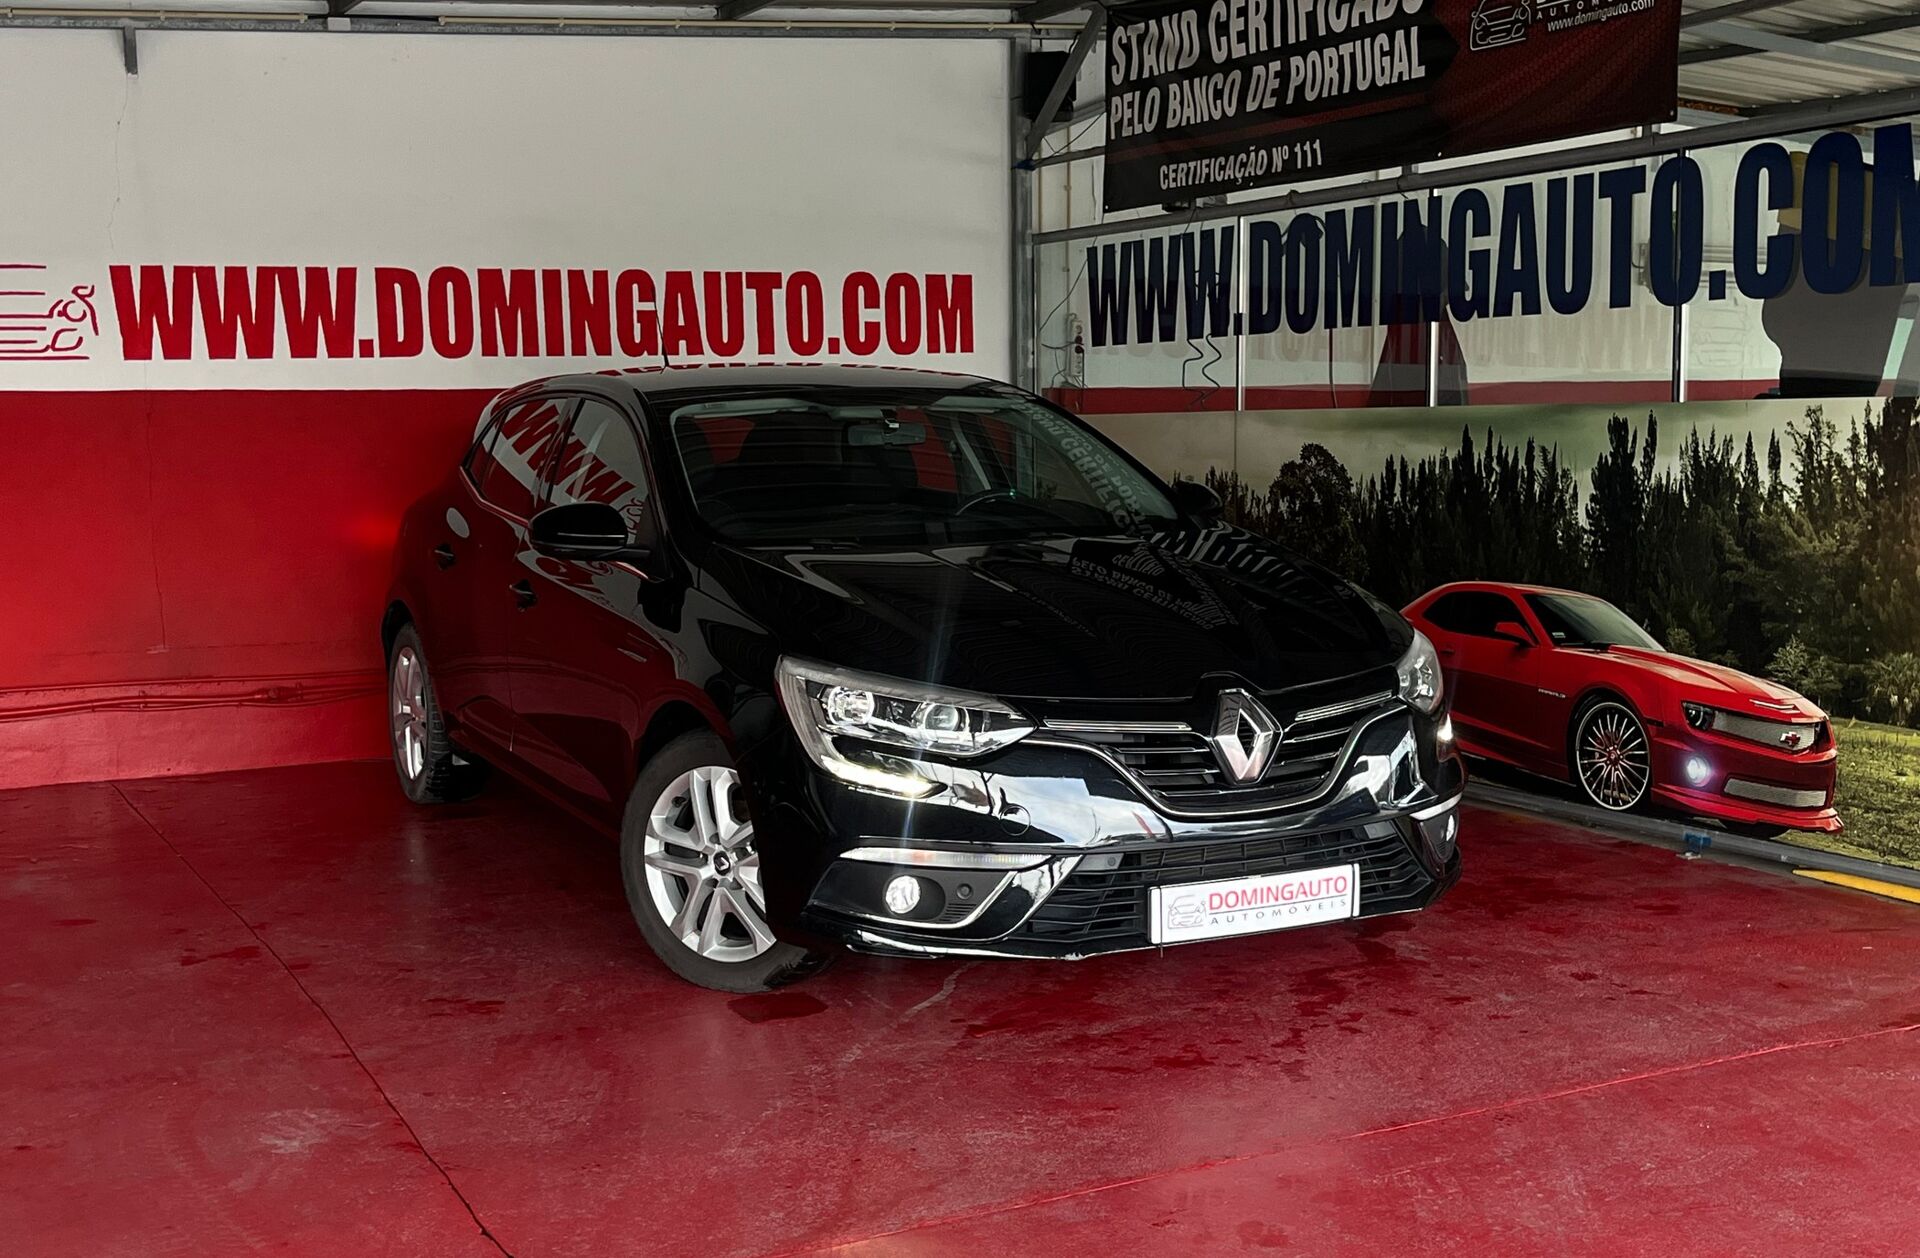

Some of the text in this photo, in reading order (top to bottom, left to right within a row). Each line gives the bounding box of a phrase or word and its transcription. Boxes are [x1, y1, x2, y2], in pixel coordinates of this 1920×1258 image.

[1110, 25, 1426, 139] PELO BANCO DE PORTUGAL
[1111, 8, 1200, 86] STAND
[1159, 144, 1268, 191] CERTIFICAÇÃO
[1294, 138, 1323, 169] 111
[109, 264, 975, 361] WWW.DOMINGAUTO.COM
[1208, 875, 1348, 911] DOMINGAUTO
